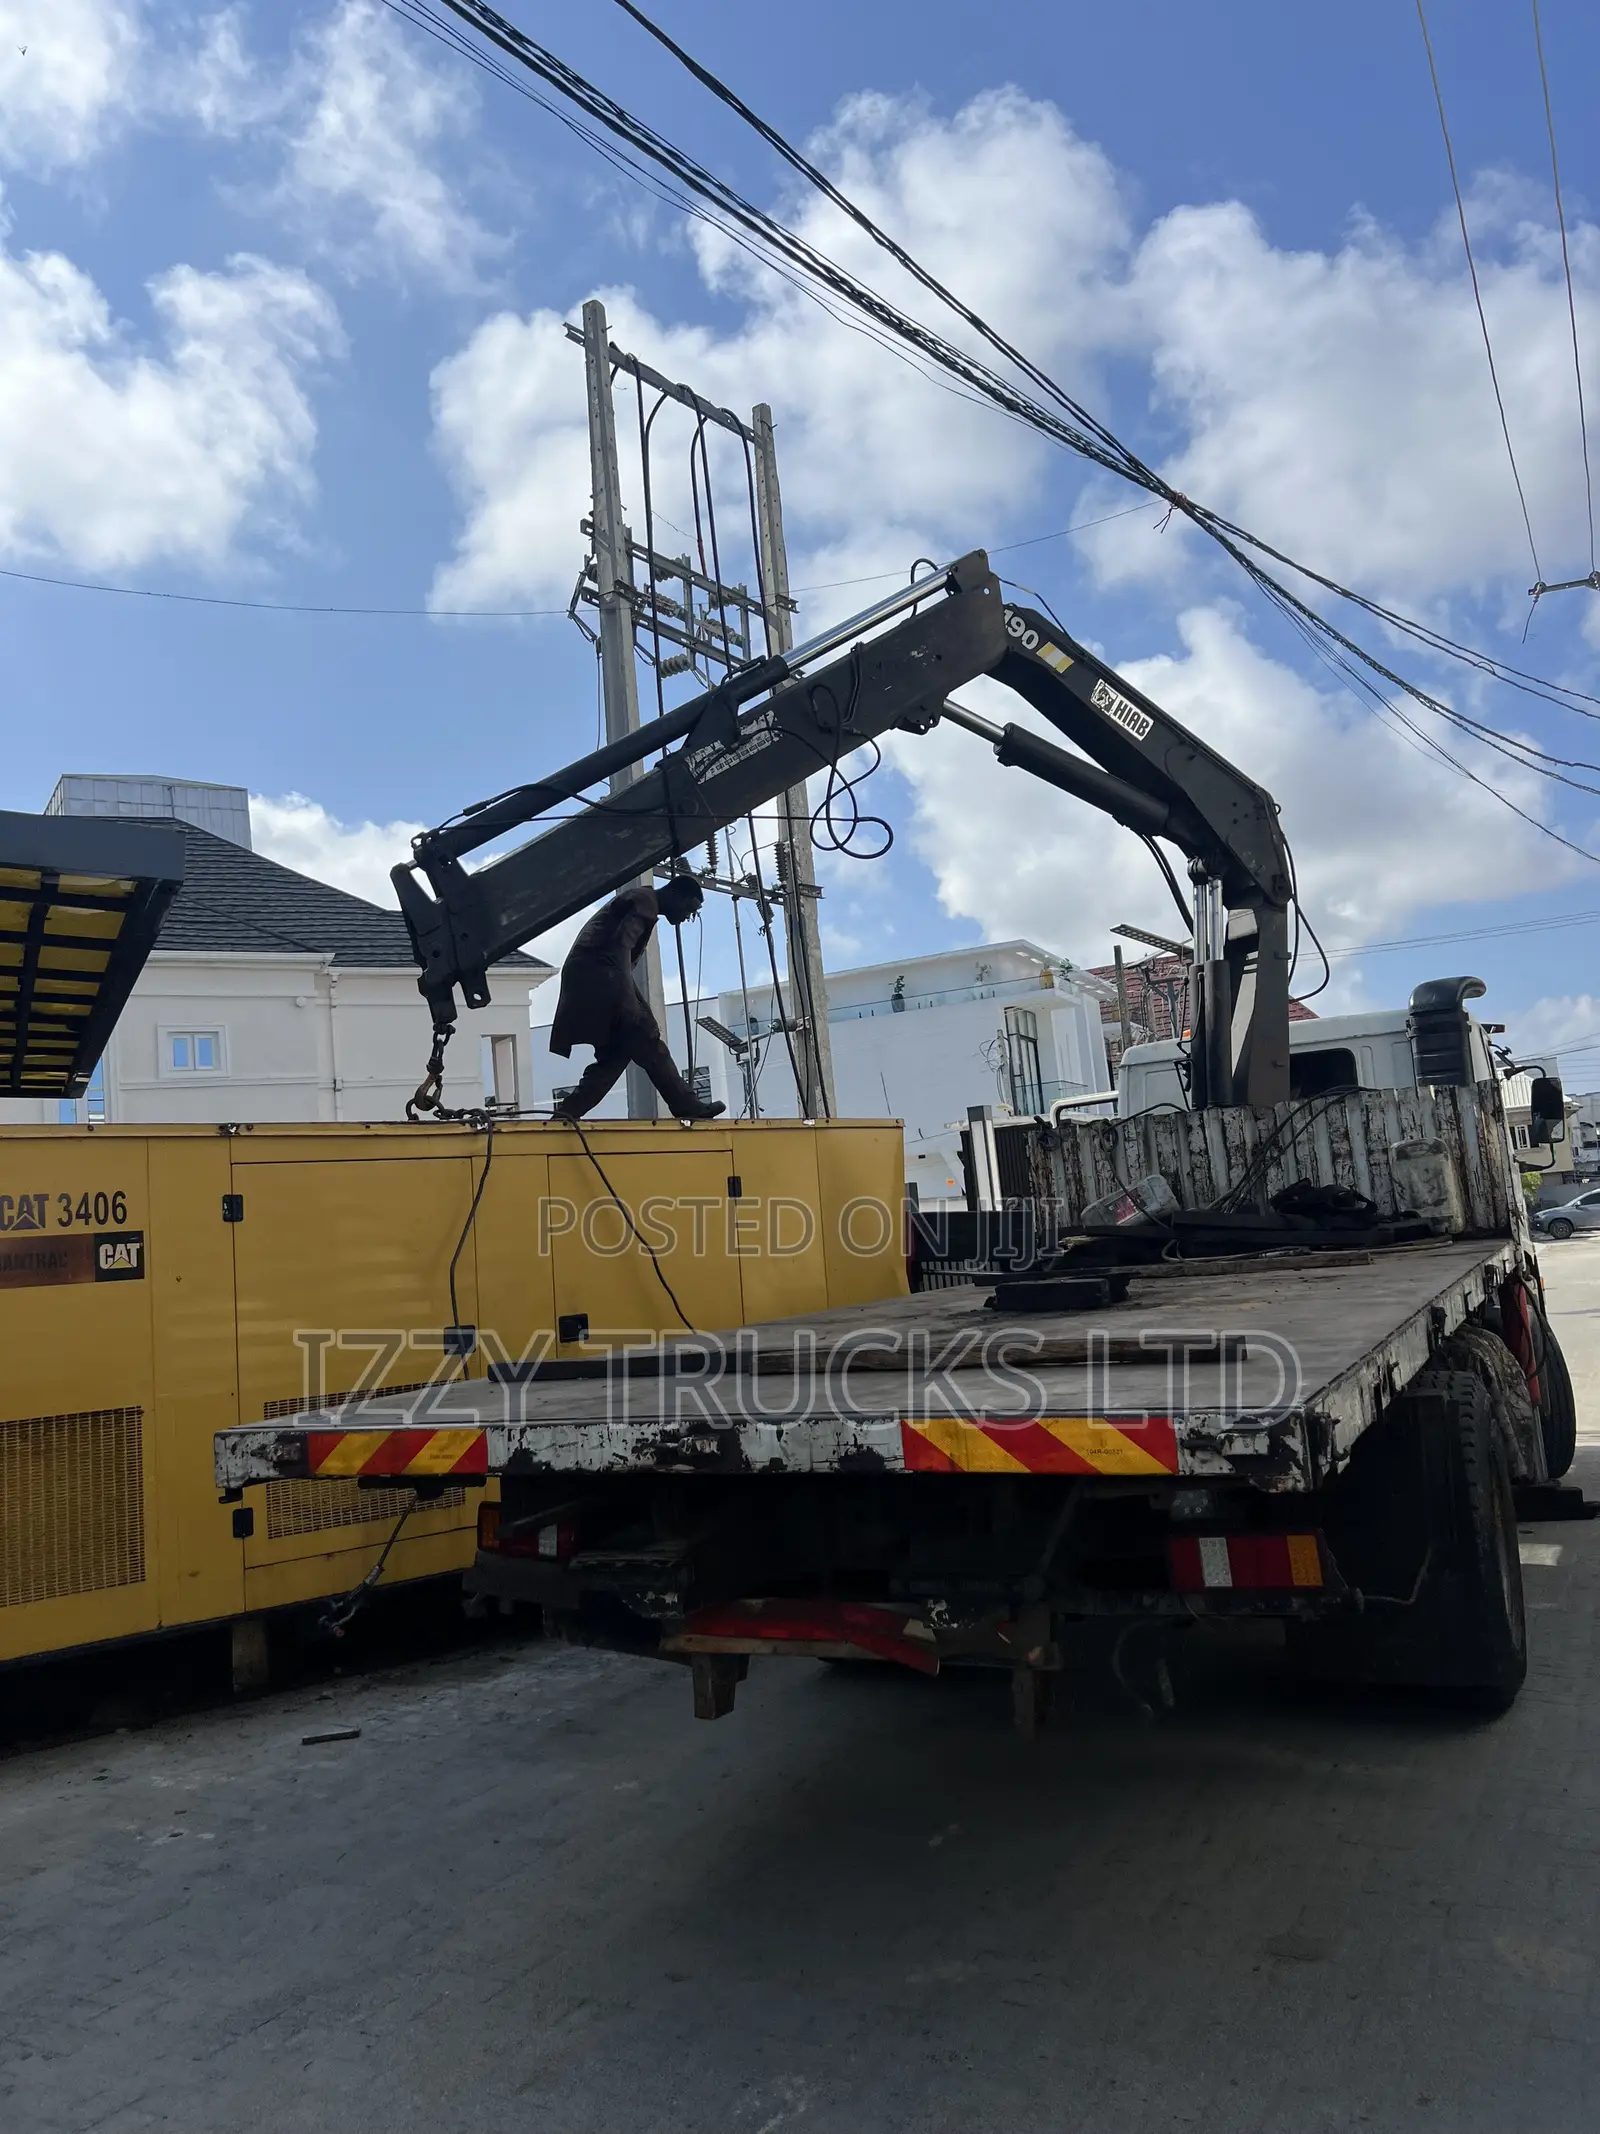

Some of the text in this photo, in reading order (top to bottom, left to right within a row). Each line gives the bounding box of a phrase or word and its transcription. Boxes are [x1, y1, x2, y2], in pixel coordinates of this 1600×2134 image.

[1112, 699, 1150, 737] HIAB
[0, 1191, 127, 1231] CAT 3406
[99, 1243, 140, 1270] CAT
